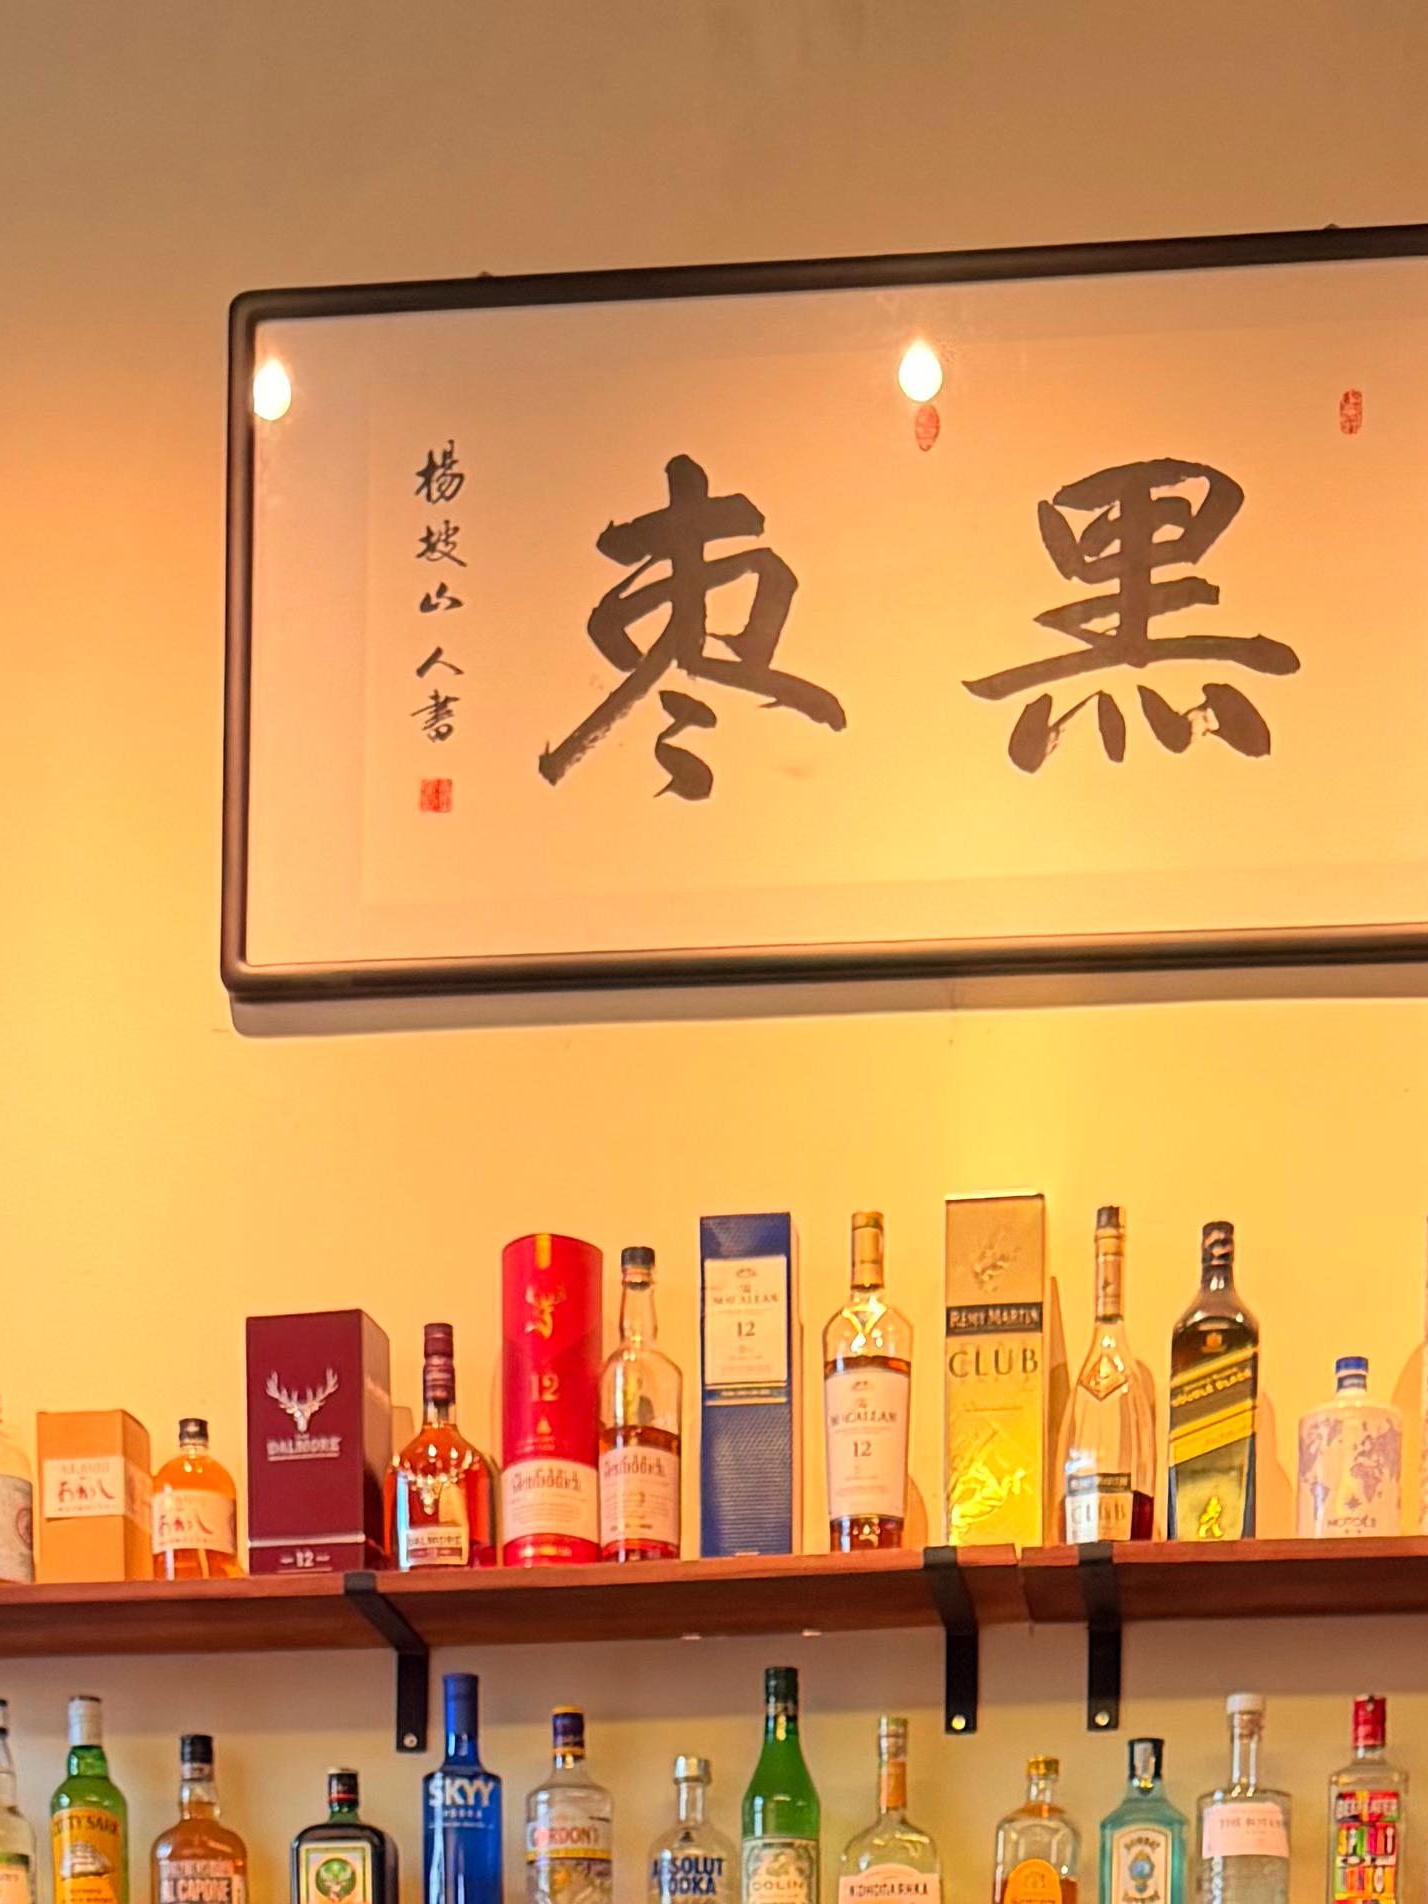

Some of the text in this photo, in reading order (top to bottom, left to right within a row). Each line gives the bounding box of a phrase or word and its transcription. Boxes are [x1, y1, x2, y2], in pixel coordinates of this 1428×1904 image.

[736, 1321, 756, 1338] 12
[948, 1348, 1039, 1378] CLUB
[530, 1373, 560, 1402] 12
[852, 1441, 872, 1457] 12
[429, 1776, 494, 1808] SKYY
